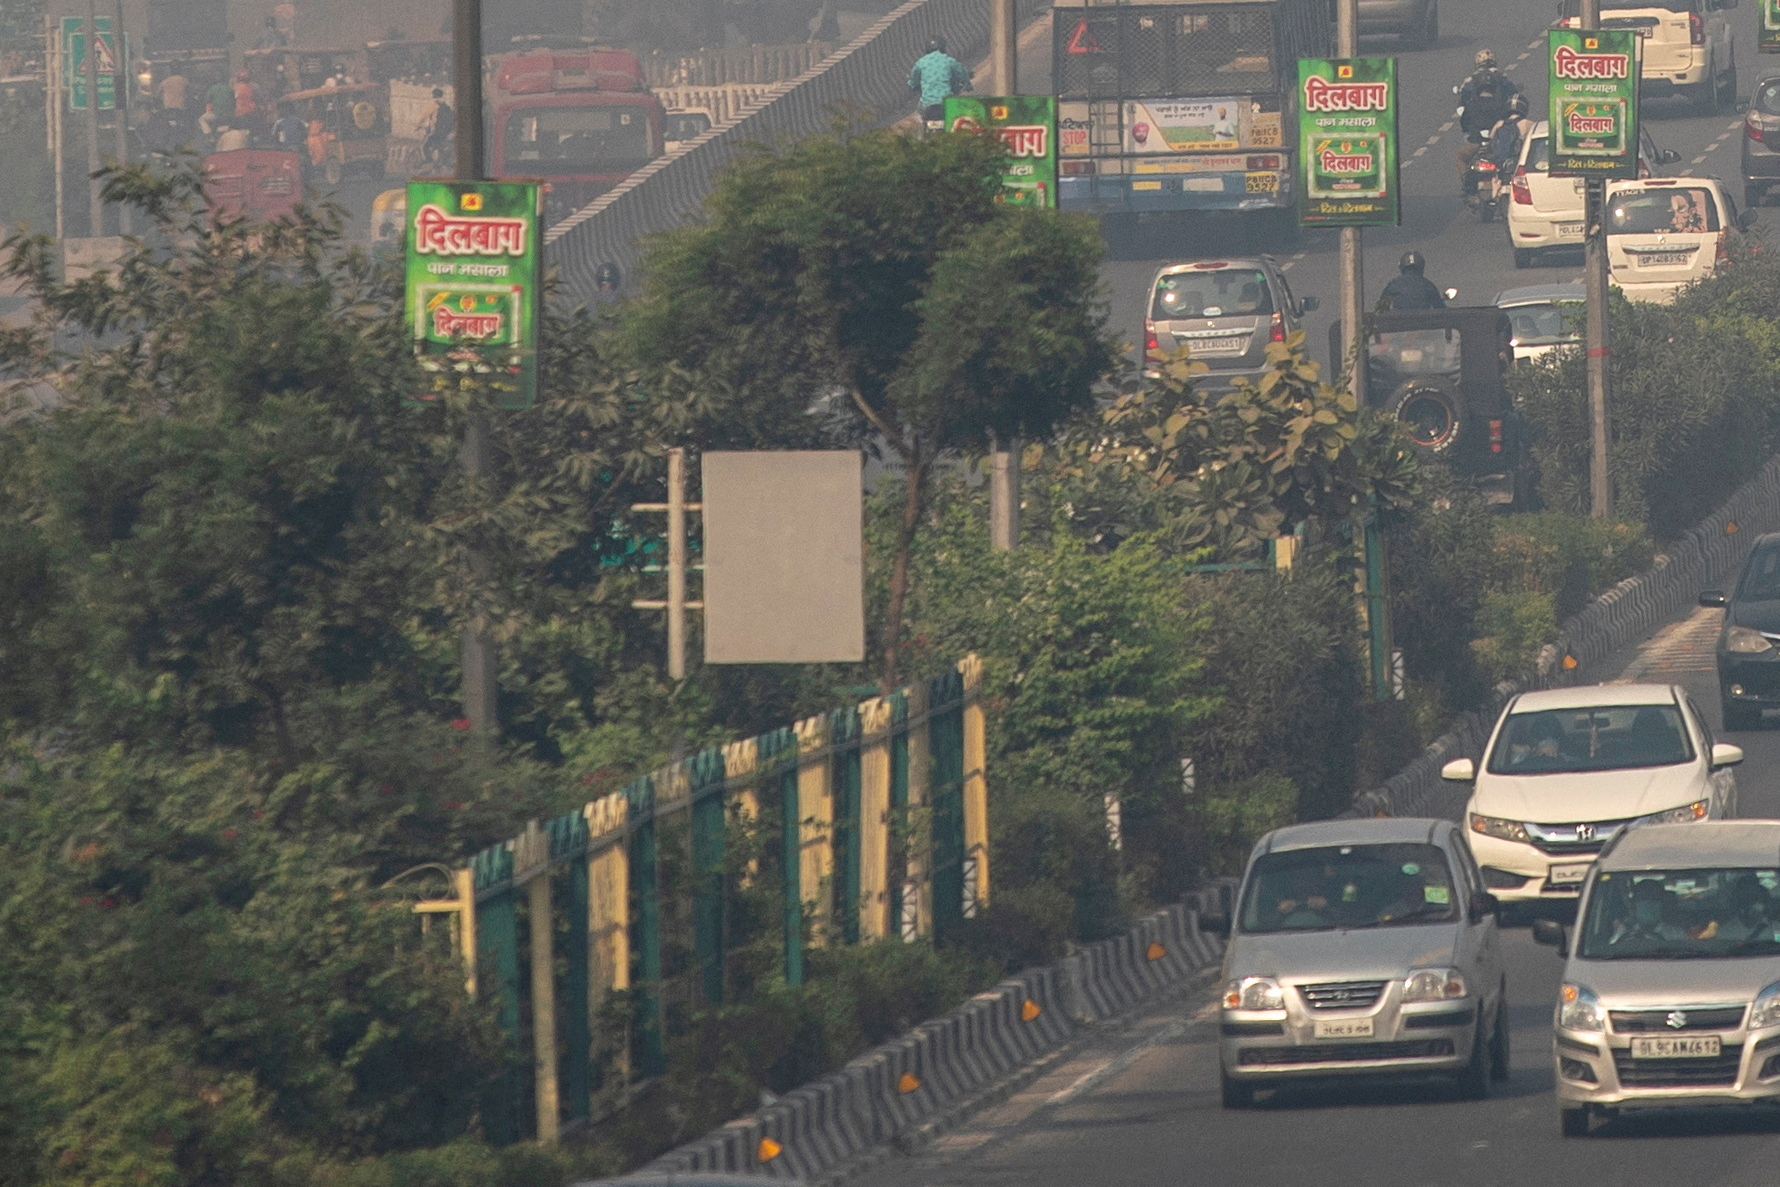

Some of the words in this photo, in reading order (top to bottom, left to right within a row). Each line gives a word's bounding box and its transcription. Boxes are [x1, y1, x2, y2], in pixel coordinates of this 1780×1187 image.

[1554, 44, 1628, 79] दिलबाग
[1305, 75, 1388, 111] दिलबाग
[1316, 117, 1336, 127] पान
[1339, 116, 1376, 127] मसाला
[1570, 112, 1614, 133] दिलबाग
[1063, 130, 1086, 144] STOP
[1322, 149, 1372, 173] दिलबाग
[1247, 182, 1274, 192] 9527
[416, 205, 527, 255] दिलबाग
[427, 262, 454, 276] पान
[458, 263, 508, 277] मसाला
[433, 305, 503, 338] दिलबाग
